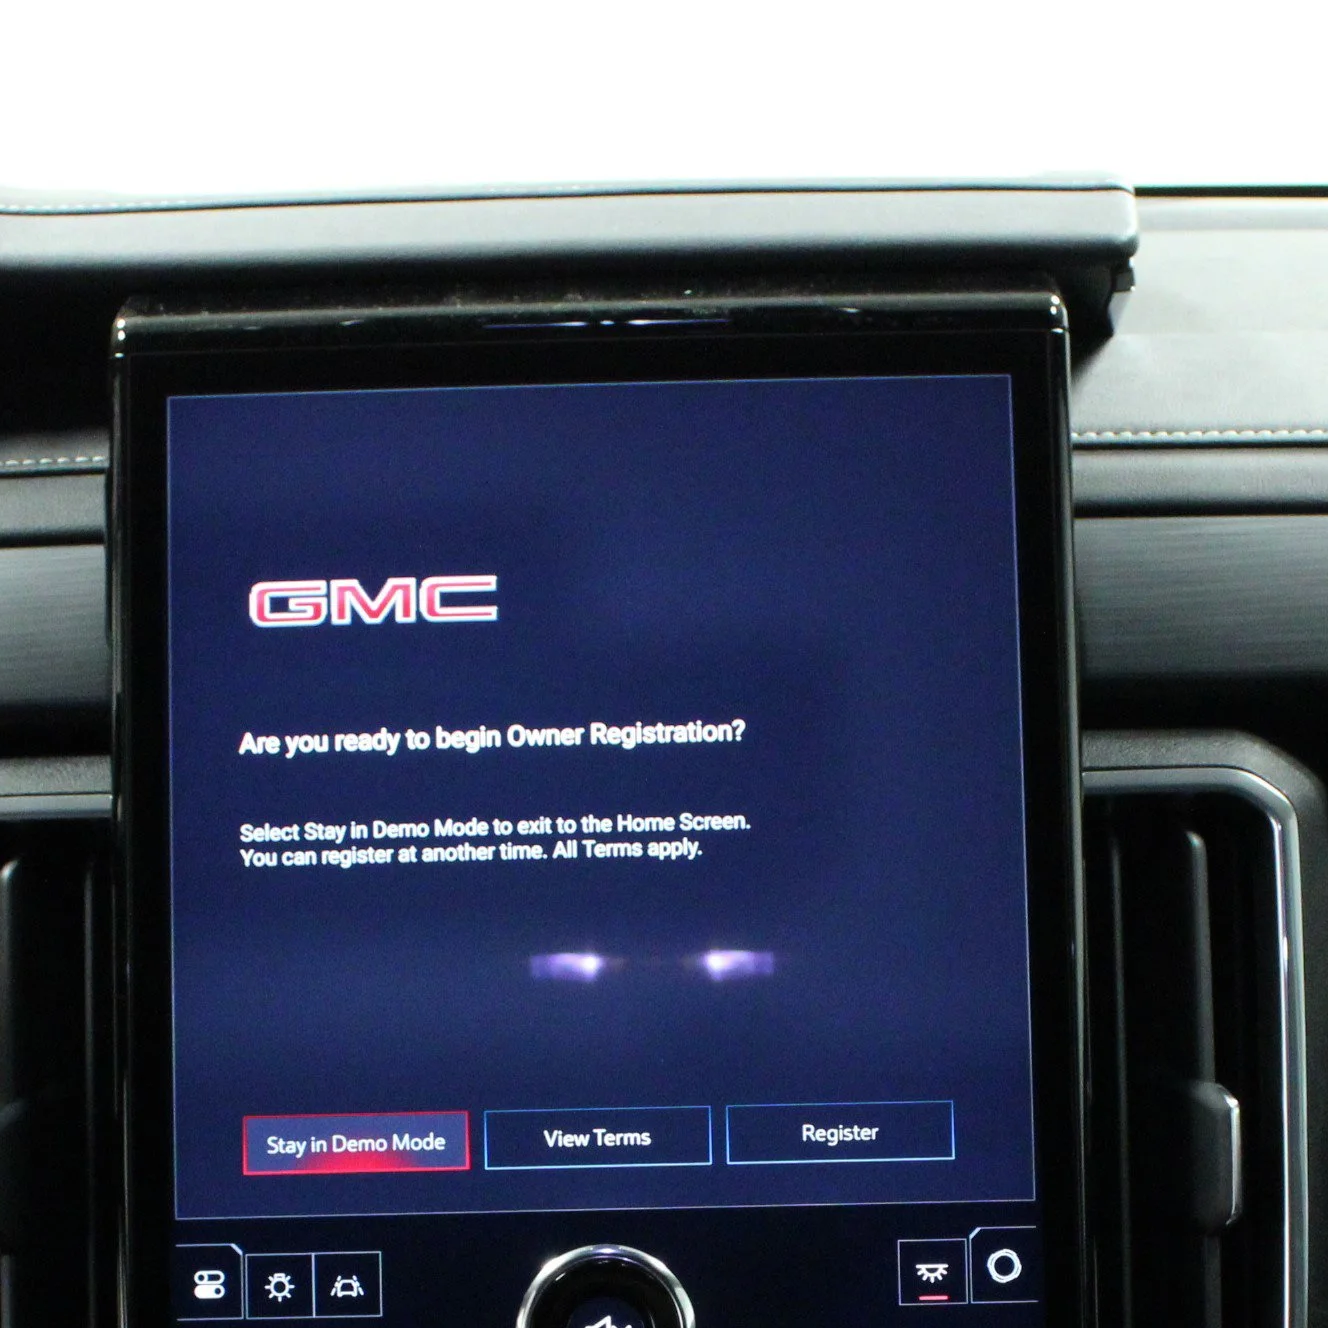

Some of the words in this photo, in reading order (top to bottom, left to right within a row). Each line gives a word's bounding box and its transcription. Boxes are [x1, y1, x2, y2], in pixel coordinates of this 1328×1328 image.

[248, 574, 499, 628] GMC
[238, 731, 281, 755] Are
[285, 734, 330, 759] you
[334, 727, 401, 756] ready
[405, 728, 431, 750] to
[435, 725, 501, 754] begin
[506, 723, 586, 748] Owner
[589, 718, 747, 750] Registration?
[239, 822, 300, 843] Select
[303, 821, 347, 844] Stay
[350, 820, 369, 839] in
[372, 819, 431, 839] Demo
[433, 816, 490, 837] Mode
[492, 818, 513, 836] to
[517, 815, 553, 836] exit
[556, 816, 577, 835] to
[580, 813, 613, 834] the
[616, 813, 676, 833] Home
[679, 812, 752, 831] Screen.
[239, 848, 278, 868] You
[281, 850, 318, 867] can
[321, 845, 395, 869] register
[397, 844, 418, 864] at
[421, 841, 496, 863] another
[499, 841, 548, 861] time.
[552, 839, 578, 859] All
[581, 839, 644, 859] Terms
[646, 836, 703, 861] apply.
[266, 1135, 307, 1159] Stay
[310, 1135, 328, 1153] in
[332, 1134, 388, 1153] Demo
[392, 1131, 446, 1151] Mode
[543, 1129, 591, 1148] View
[592, 1128, 652, 1147] Terms
[801, 1123, 880, 1147] Register
